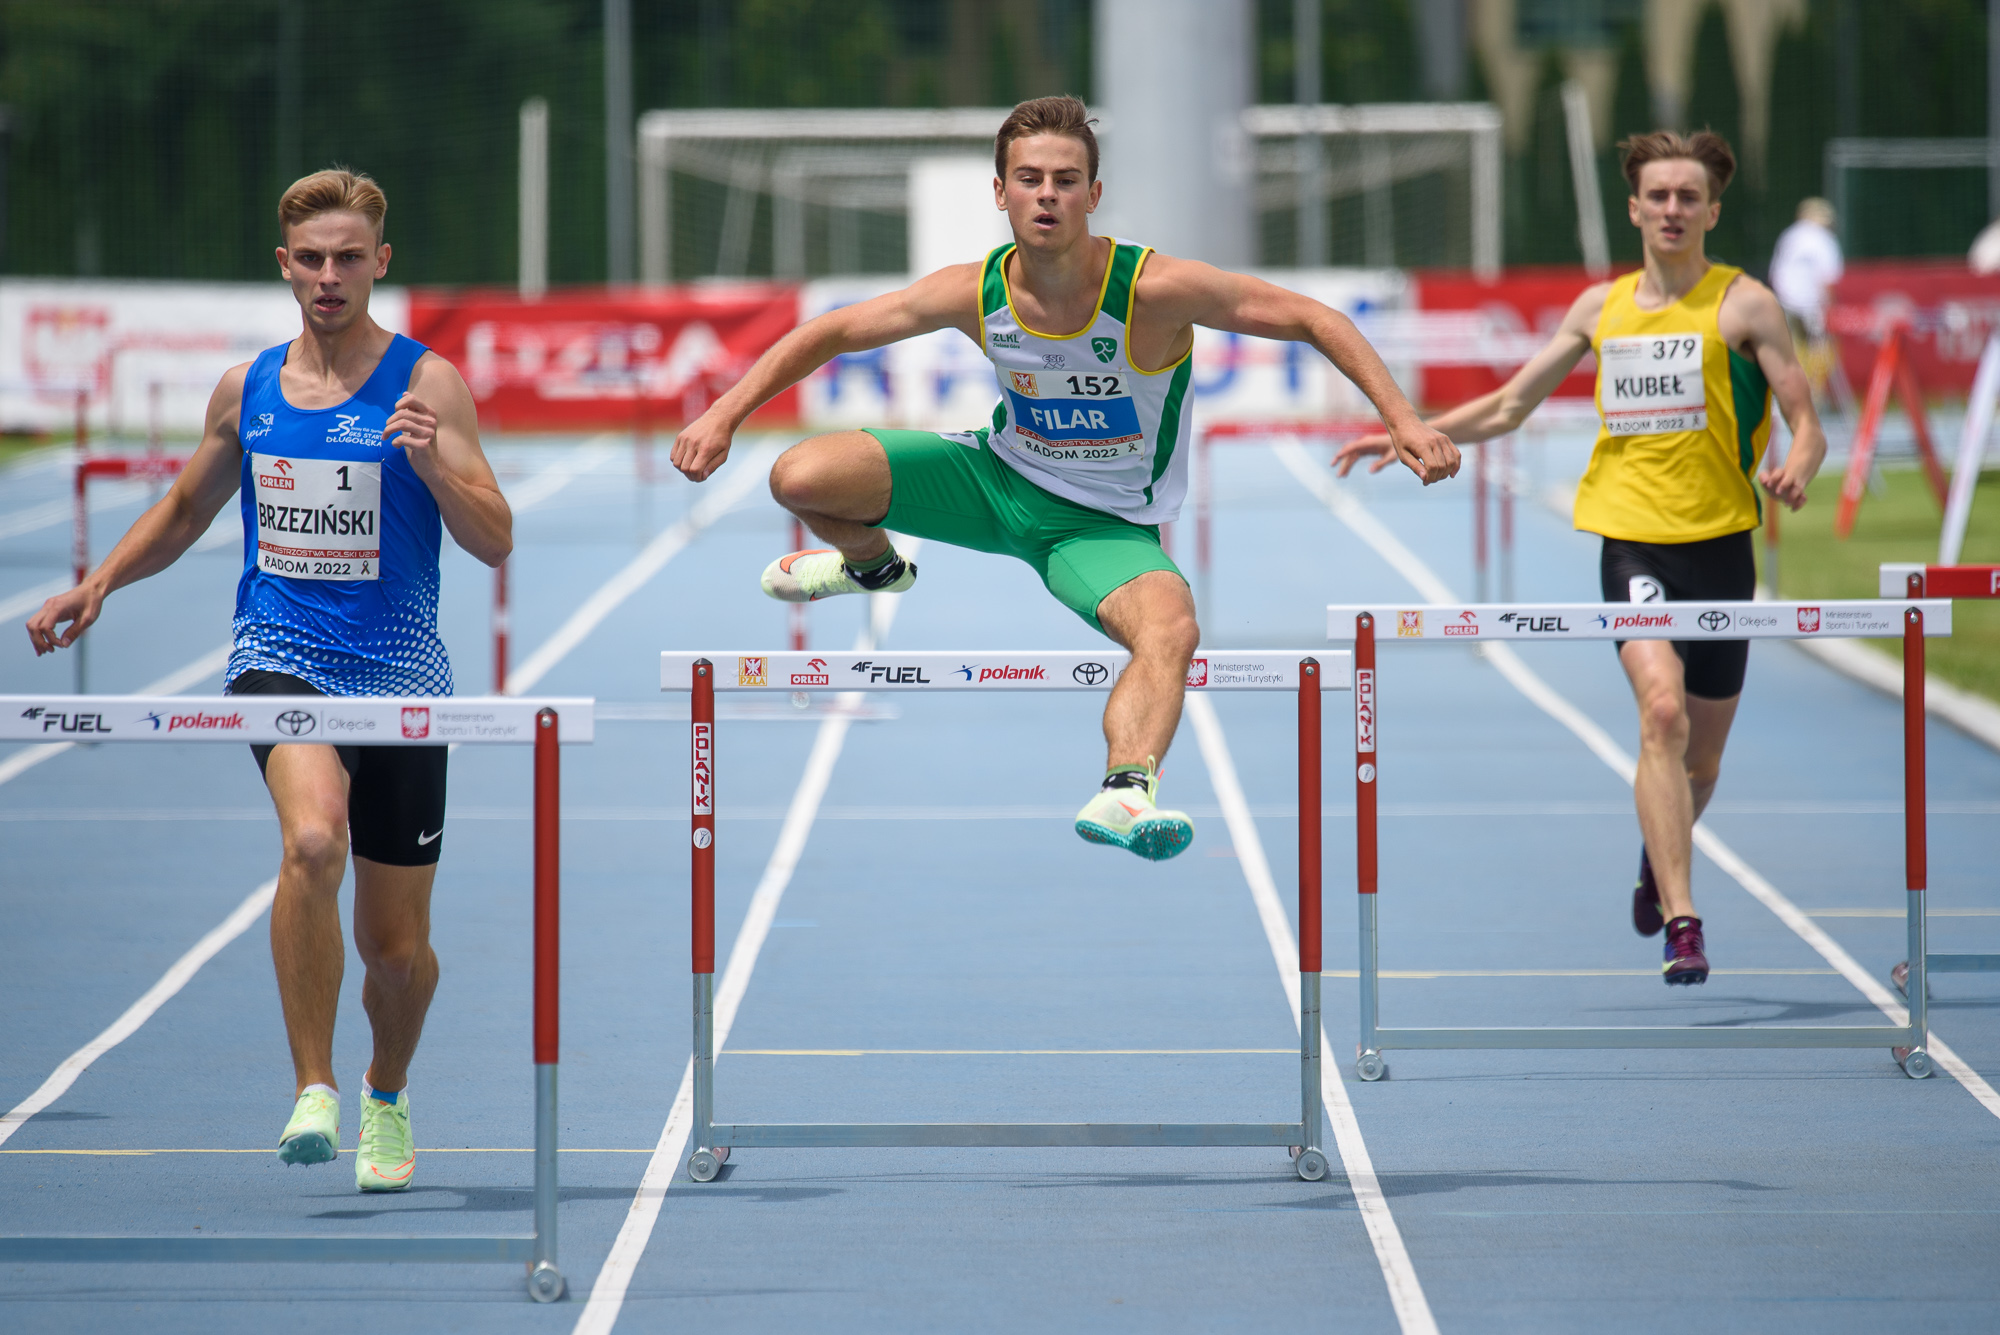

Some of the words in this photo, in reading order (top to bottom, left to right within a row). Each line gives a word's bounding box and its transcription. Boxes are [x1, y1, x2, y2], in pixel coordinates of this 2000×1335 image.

[992, 333, 1020, 343] ZLKL
[1652, 339, 1696, 360] 379
[1066, 375, 1123, 396] 152
[1615, 374, 1685, 398] KUBEŁ
[1030, 406, 1110, 430] FILAR
[1607, 420, 1651, 433] RADOM
[1655, 418, 1685, 430] 2022
[1025, 441, 1079, 459] RADOM
[1082, 447, 1119, 459] 2022
[260, 476, 293, 490] ORLEN
[336, 465, 352, 491] 1
[258, 502, 374, 536] BRZEZIŃSKI
[273, 546, 325, 557] MISTRZOSTWA
[264, 555, 309, 574] RADOM
[313, 562, 351, 575] 2022
[1499, 613, 1518, 623] 4F
[1515, 617, 1570, 632] FUEL
[1612, 612, 1675, 631] polanik
[1739, 614, 1778, 629] Okęcie
[1825, 611, 1873, 619] Ministerstwo
[1446, 626, 1477, 635] ORLEN
[1825, 621, 1850, 631] Sportu
[1855, 621, 1890, 631] Turystyki
[851, 661, 873, 673] 4F
[870, 667, 931, 684] FUEL
[978, 663, 1047, 683] polanik
[1213, 662, 1265, 672] Ministerstwo
[740, 676, 766, 685] PZLA
[792, 675, 828, 684] ORLEN
[1213, 674, 1241, 684] Sportu
[1247, 674, 1284, 685] Turystyki
[435, 712, 496, 723] Ministerstwo
[1359, 672, 1372, 746] POLANIK
[20, 707, 46, 720] 4F
[43, 713, 113, 733] FUEL
[167, 711, 245, 733] polanik
[327, 717, 377, 733] Okęcie
[694, 725, 711, 808] POLANIK
